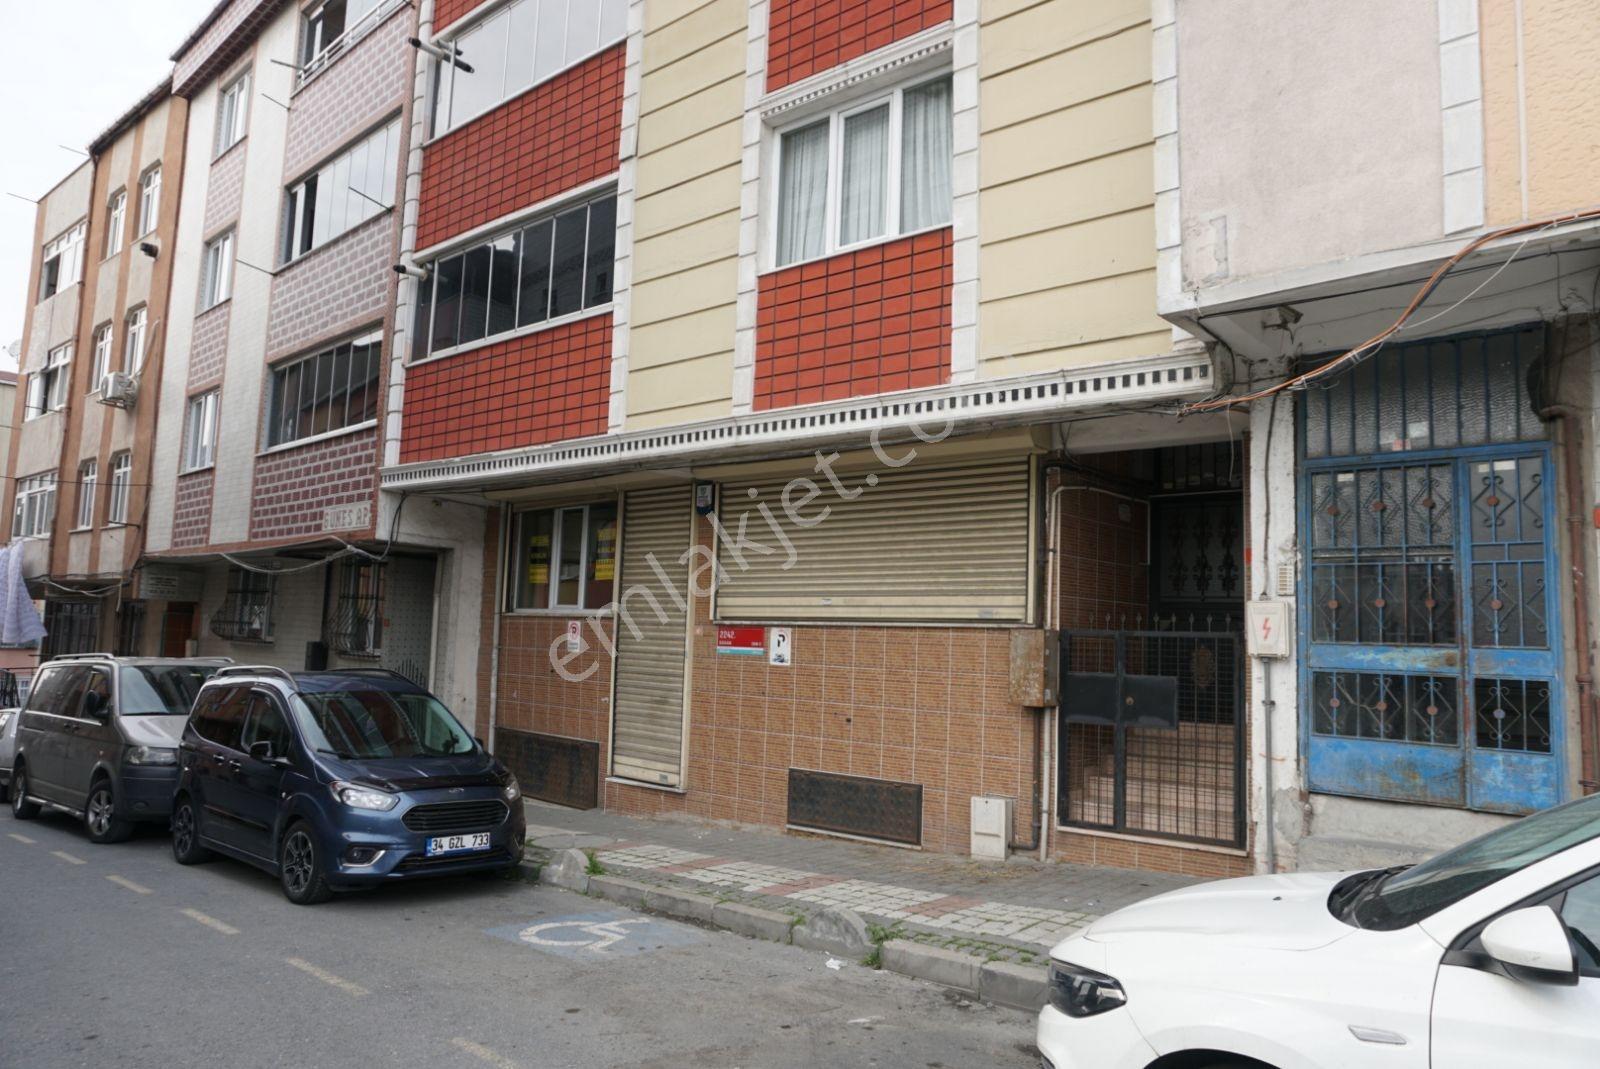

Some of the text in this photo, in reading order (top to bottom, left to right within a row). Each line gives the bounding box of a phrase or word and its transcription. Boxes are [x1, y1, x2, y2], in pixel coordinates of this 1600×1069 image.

[432, 834, 489, 851] 34 GZL 733
